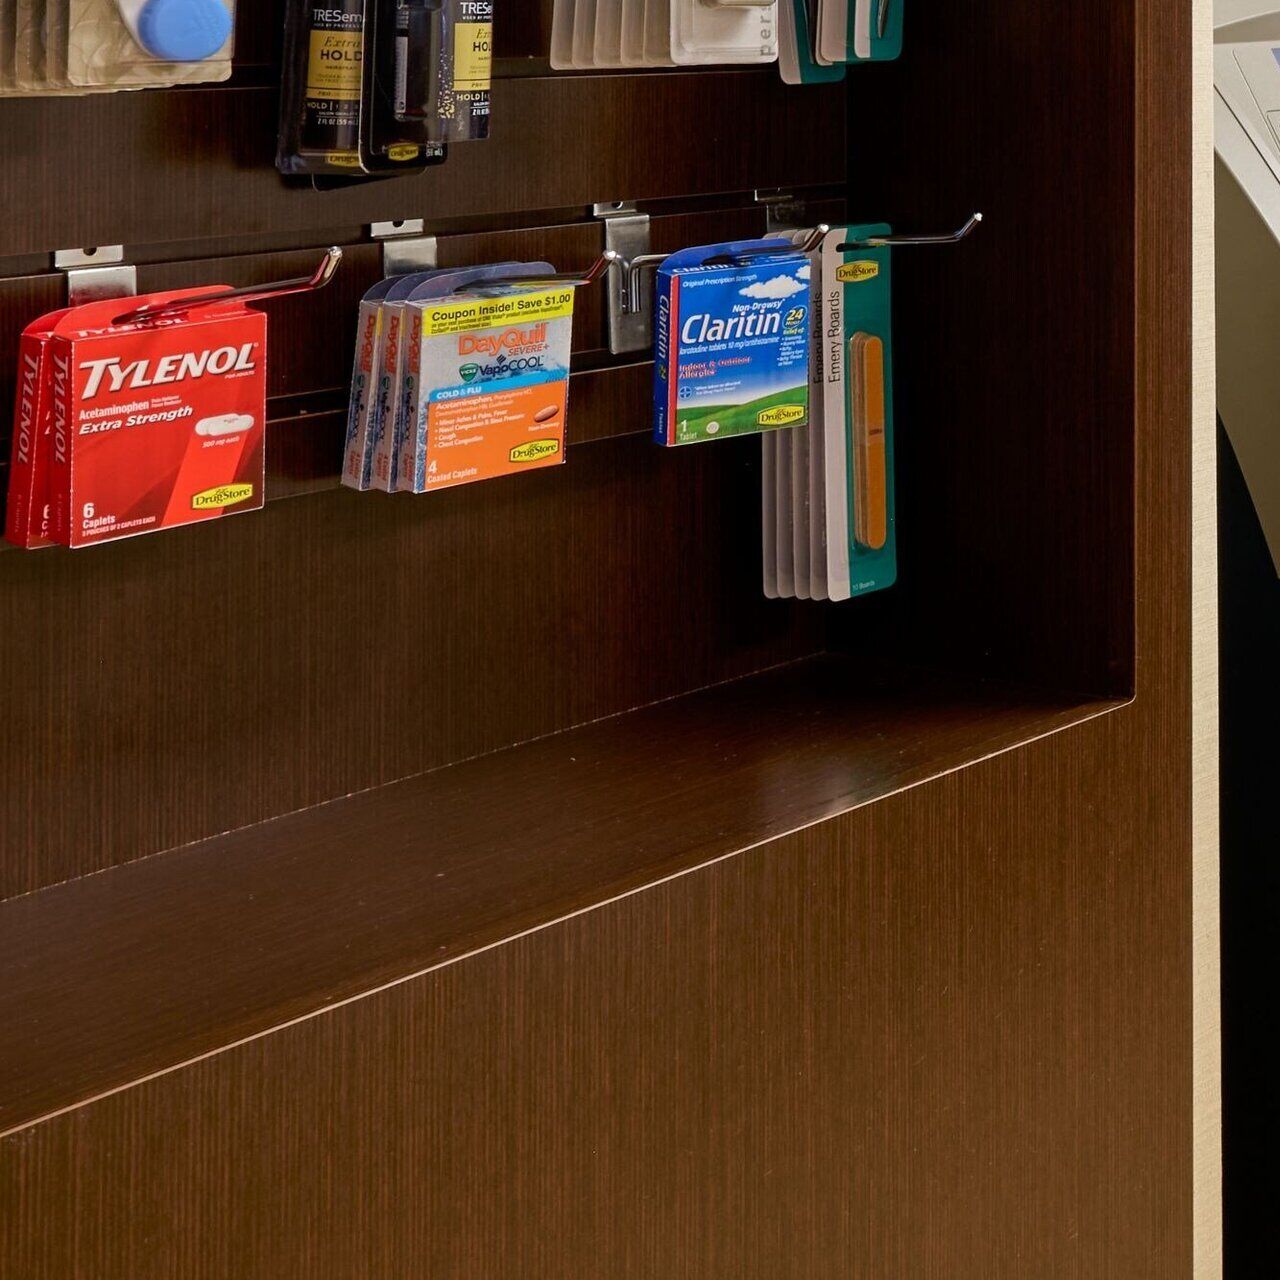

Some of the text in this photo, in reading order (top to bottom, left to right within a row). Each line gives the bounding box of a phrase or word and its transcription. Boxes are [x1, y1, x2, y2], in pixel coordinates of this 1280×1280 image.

[313, 9, 362, 22] TRESem
[324, 36, 361, 48] Extra
[320, 50, 362, 62] HOLD
[456, 93, 480, 101] HOLD
[839, 267, 877, 278] DrugStore
[682, 279, 704, 288] Original
[704, 277, 735, 286] Prescription
[432, 293, 571, 321] Coupon Inside! Save $1.00
[732, 300, 782, 313] Non-Drowsy
[787, 308, 803, 321] 24
[658, 294, 669, 359] Claritin
[681, 310, 780, 344] Claritin
[458, 322, 547, 356] DayQuil
[827, 290, 843, 383] Emery Boards
[508, 343, 550, 357] SEVERE+
[79, 343, 256, 400] TYLENOL
[479, 356, 544, 378] VapoCOOL
[436, 388, 459, 399] COLD
[467, 386, 482, 395] FLU
[17, 354, 40, 464] TYLENOL
[53, 354, 69, 463] TYLENOL
[79, 399, 149, 420] Acetaminophen
[79, 406, 193, 435] Extra Strength
[761, 410, 802, 423] DrugStore
[681, 419, 688, 432] 1
[513, 444, 556, 459] DrugStore
[429, 461, 437, 473] 4
[428, 468, 477, 483] Coated Caplets
[195, 488, 251, 506] DrugStore
[83, 502, 95, 518] 6
[82, 515, 116, 529] Caplets
